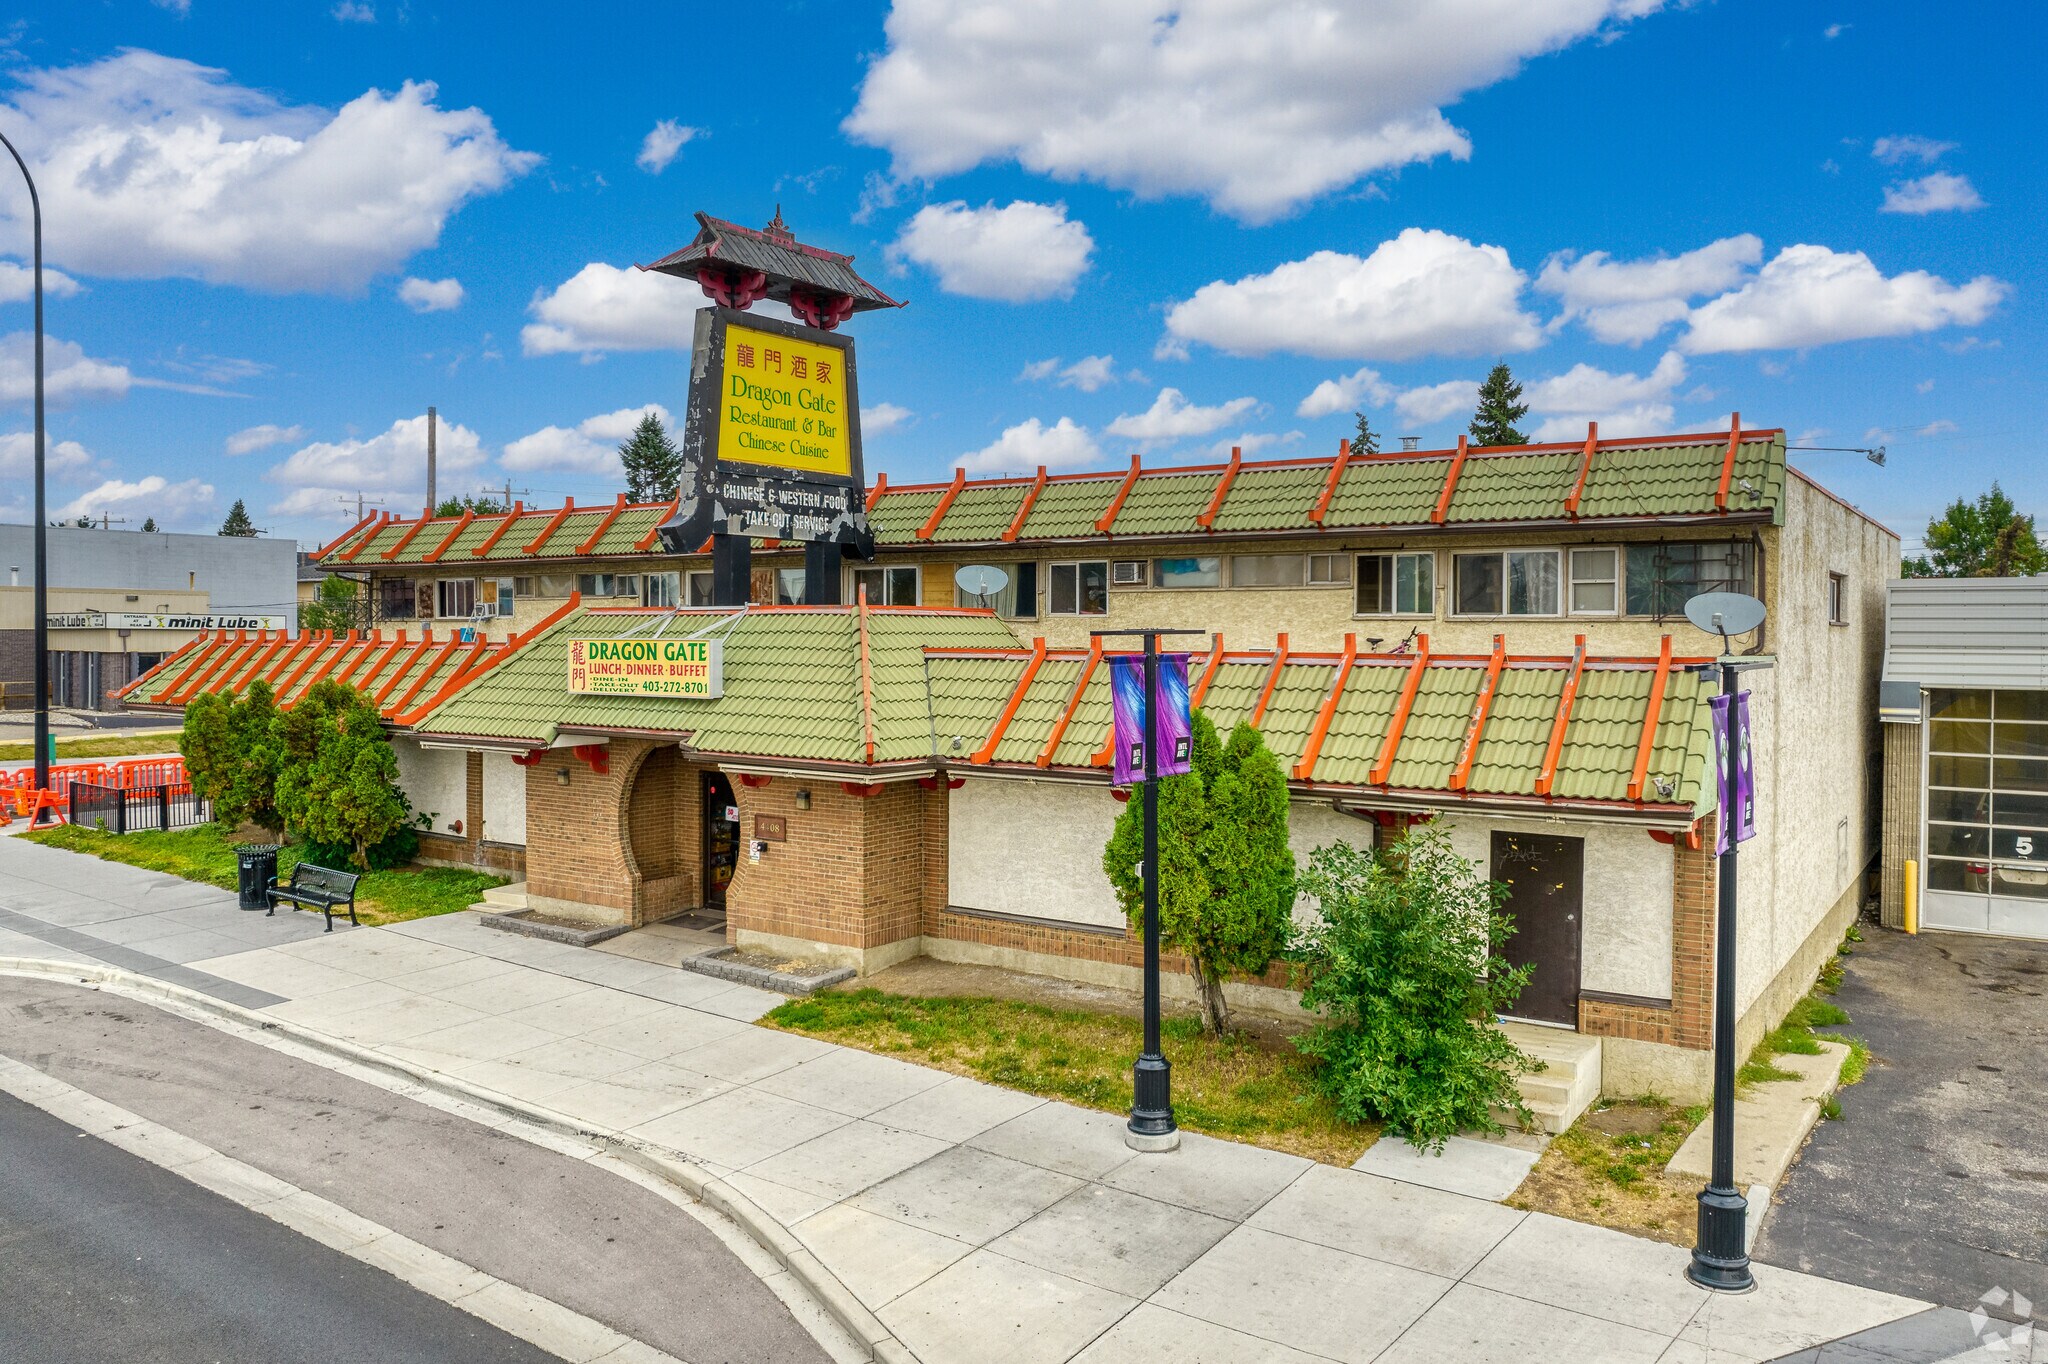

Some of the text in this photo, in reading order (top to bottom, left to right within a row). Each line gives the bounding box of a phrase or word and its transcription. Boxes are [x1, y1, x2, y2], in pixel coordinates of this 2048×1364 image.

[737, 343, 832, 385] 龍門酒家
[731, 375, 836, 413] Dragon Gate
[730, 405, 837, 438] Restaurant & Bar
[738, 431, 829, 459] Chinese Cuisine
[723, 483, 847, 510] CHINESE & WESTERN FOOD
[793, 514, 829, 532] SERVICE
[67, 615, 86, 627] Lube
[168, 616, 258, 629] minit Lube
[589, 642, 707, 662] DRAGON GATE
[571, 641, 586, 690] 龍門
[589, 663, 707, 677] LUNCH DINNER BUFFET
[642, 681, 708, 694] 403-272-8701
[760, 822, 780, 832] 408
[2015, 836, 2033, 855] 5
